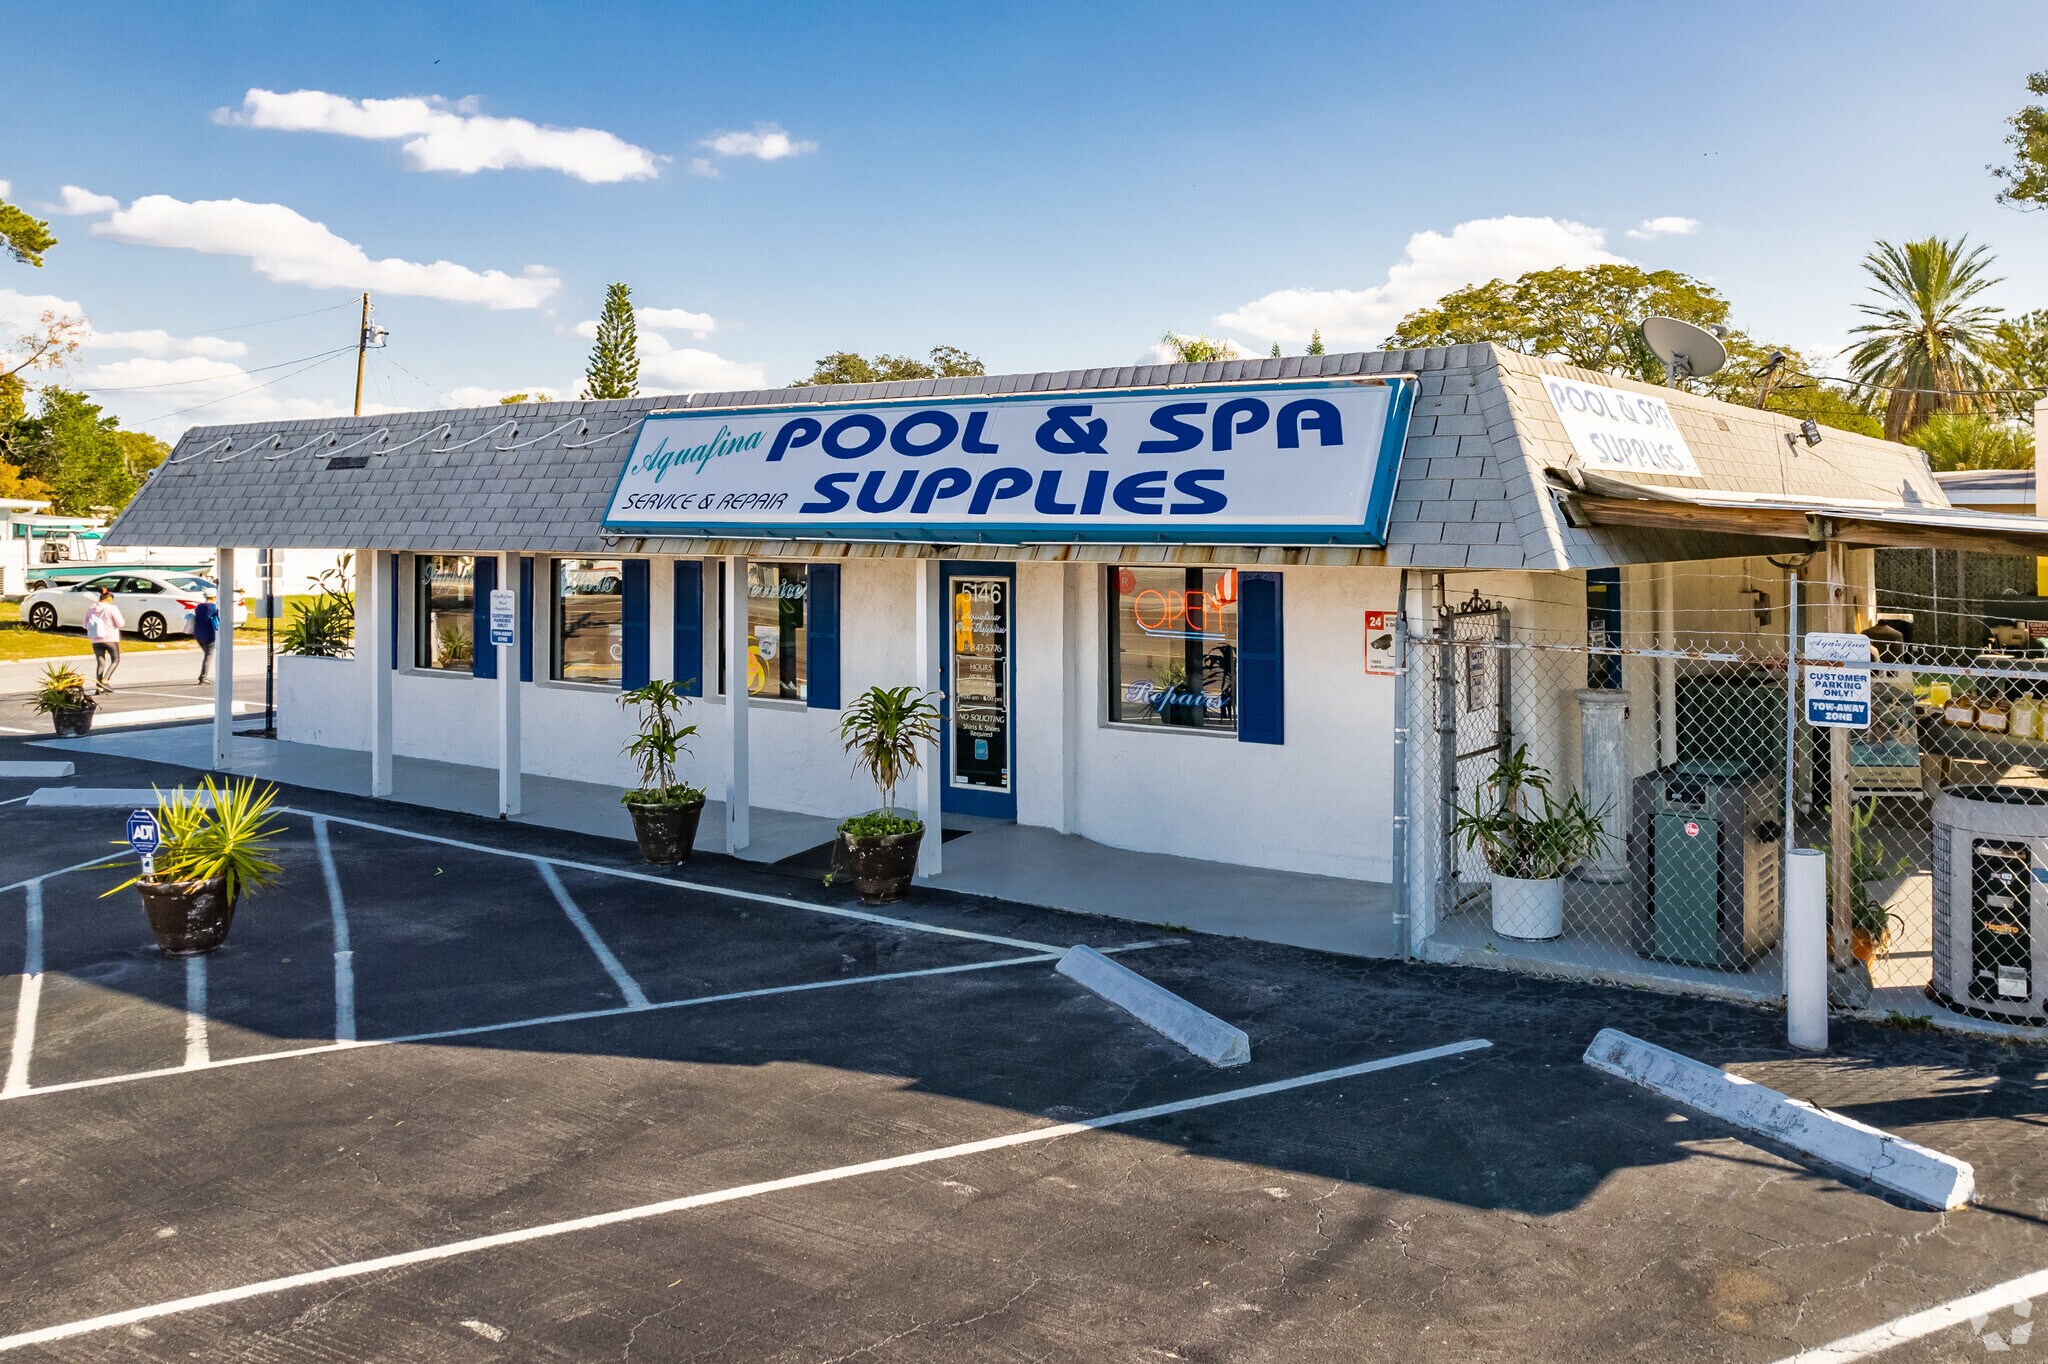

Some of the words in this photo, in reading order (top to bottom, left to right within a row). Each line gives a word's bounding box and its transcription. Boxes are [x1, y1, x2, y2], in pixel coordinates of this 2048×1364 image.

[1550, 382, 1619, 422] POOL
[1616, 394, 1640, 425] &
[1637, 398, 1676, 431] SPA
[765, 410, 999, 462] POOL
[1035, 405, 1109, 455] &
[1137, 398, 1344, 454] SPA
[631, 425, 768, 484] Aquafina
[1589, 432, 1685, 471] SUPPLIES
[799, 467, 1228, 515] SUPPLIES
[622, 493, 698, 510] SERVICE
[698, 493, 716, 510] &
[716, 492, 789, 510] REPAIR
[748, 577, 807, 599] ervice
[962, 582, 1002, 604] 5146
[1134, 589, 1223, 632] OPEN
[1370, 616, 1382, 627] 24
[1809, 639, 1866, 650] Aquafina
[969, 663, 993, 671] HOURS
[1809, 672, 1868, 682] CUSTOMER
[1815, 680, 1862, 690] PARKING
[1125, 680, 1231, 714] Repairs
[1823, 689, 1854, 697] ONLY!
[1812, 702, 1866, 713] TOW-AWAY
[958, 713, 969, 721] NO
[970, 713, 1005, 724] SOLICITING
[1825, 712, 1853, 722] ZONE
[970, 730, 993, 738] Required
[132, 824, 154, 841] ADT
[1984, 920, 2019, 934] HeatPro
